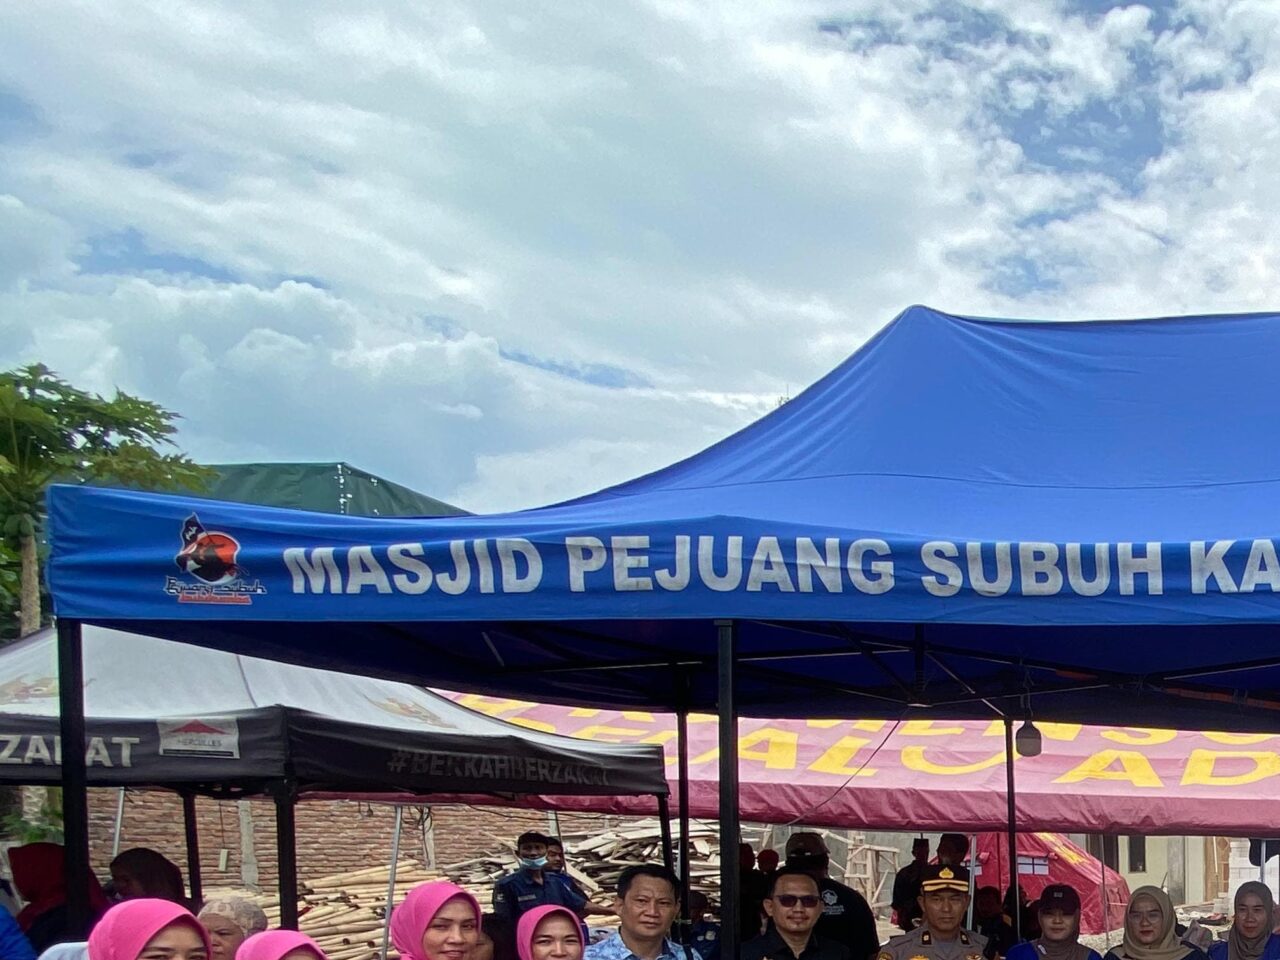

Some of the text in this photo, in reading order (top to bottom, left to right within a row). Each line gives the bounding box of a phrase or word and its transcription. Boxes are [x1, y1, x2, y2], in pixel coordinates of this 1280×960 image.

[282, 537, 544, 595] MASJID
[566, 535, 897, 595] PEJUANG
[920, 540, 1163, 597] SUBUH
